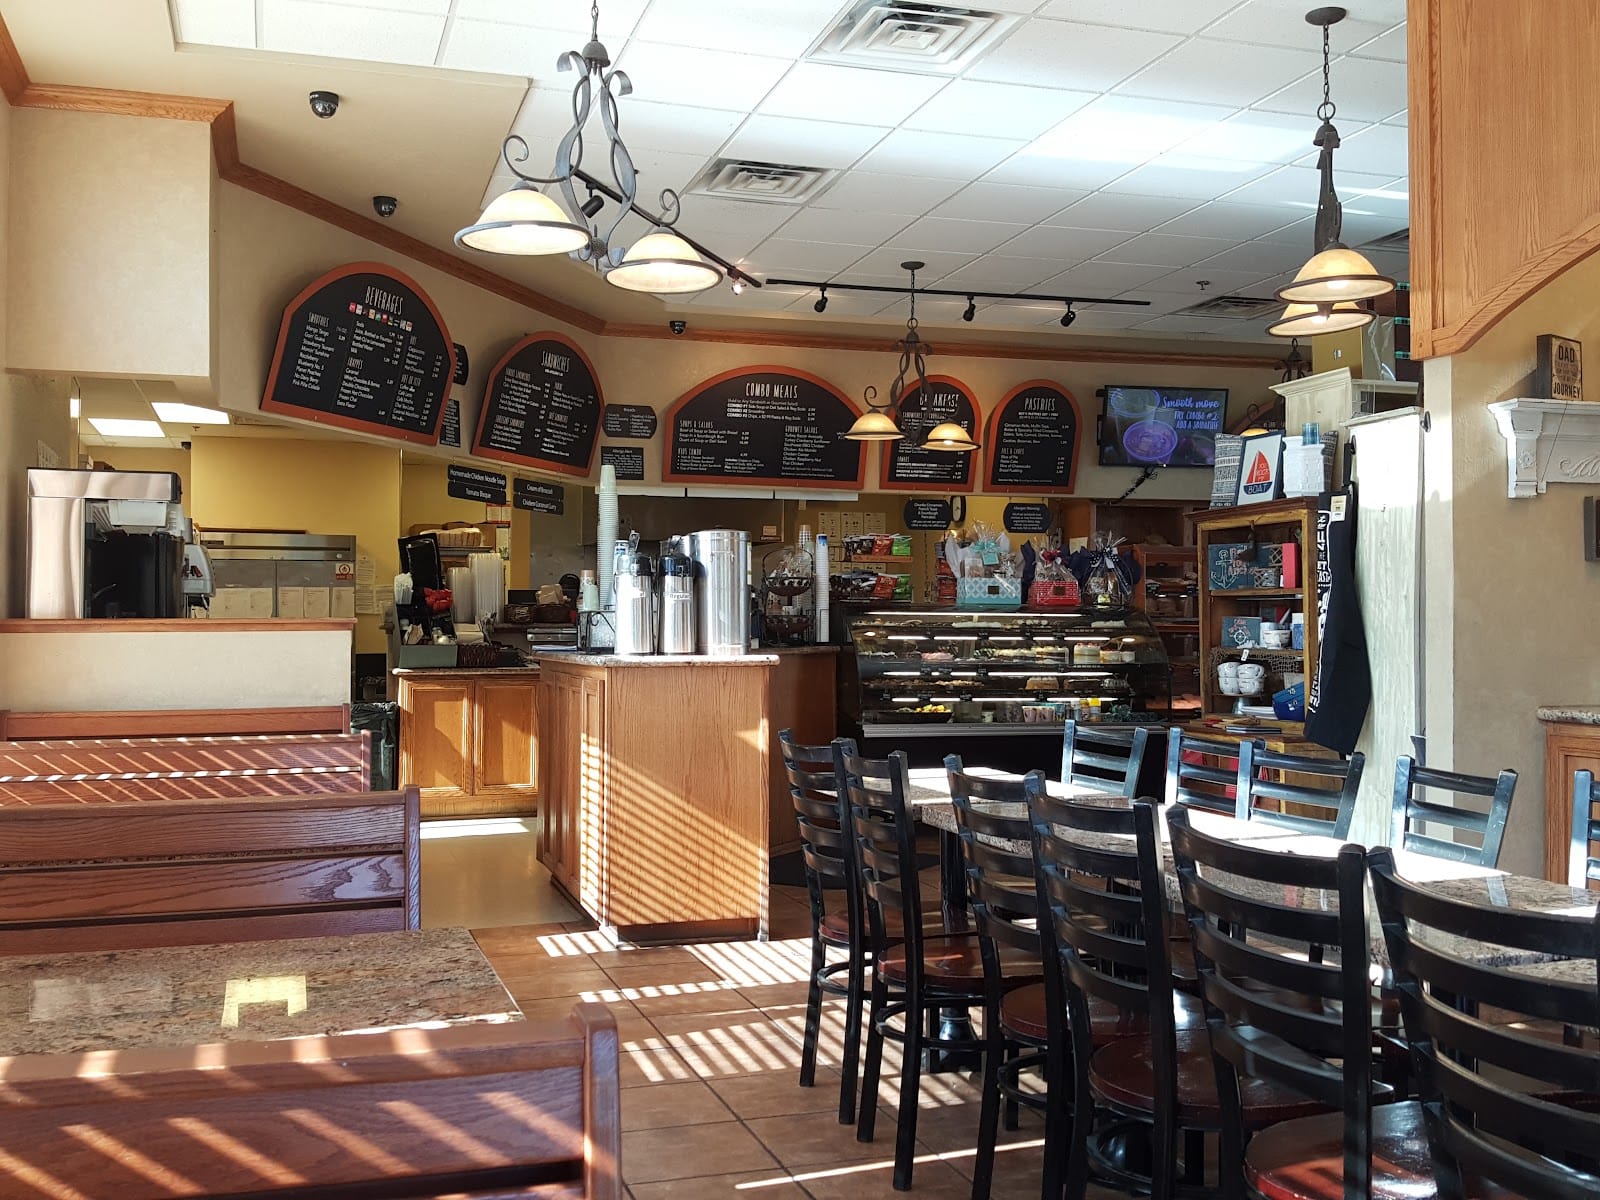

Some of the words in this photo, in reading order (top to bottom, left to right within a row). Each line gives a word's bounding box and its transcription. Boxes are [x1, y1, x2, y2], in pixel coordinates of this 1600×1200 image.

[365, 286, 403, 315] BEVERAGES
[1559, 345, 1575, 362] DAD
[746, 383, 770, 397] COMBO
[774, 384, 798, 399] MEALS
[1554, 382, 1581, 399] JOURNEY
[1025, 398, 1056, 411] PASTRIES
[1162, 397, 1193, 409] Smooth
[1196, 400, 1219, 408] move
[1248, 484, 1268, 495] BOAT
